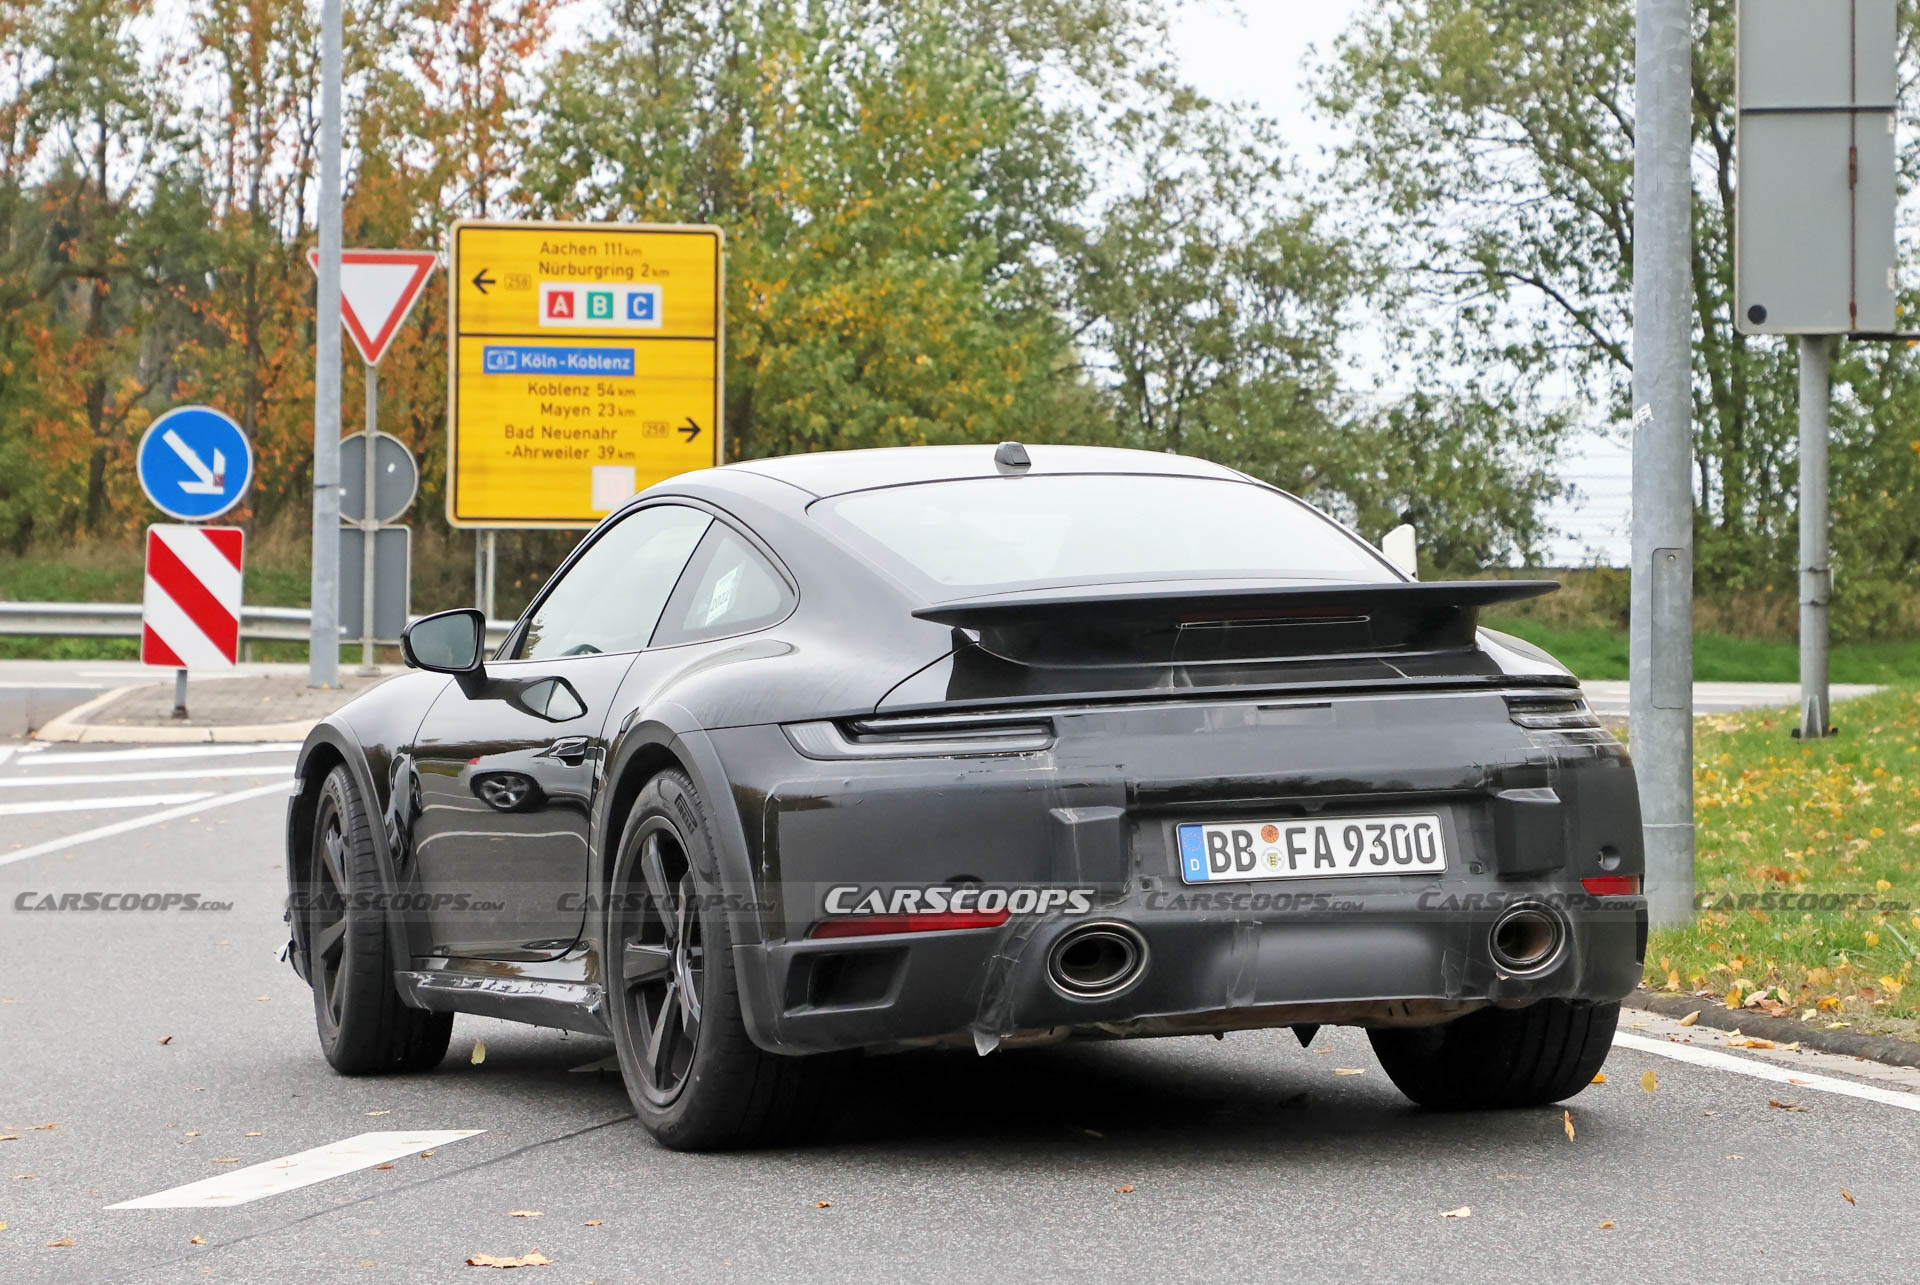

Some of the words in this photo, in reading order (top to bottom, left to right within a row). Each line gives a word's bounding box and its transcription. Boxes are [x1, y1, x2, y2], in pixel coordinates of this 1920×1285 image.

[540, 241, 597, 256] Aachen
[604, 242, 622, 257] 111
[539, 261, 634, 280] Nürburgring
[641, 264, 650, 278] 2
[652, 268, 670, 277] km
[551, 294, 569, 316] A
[592, 295, 608, 316] B
[632, 295, 648, 317] C
[528, 382, 590, 397] Koblenz
[597, 384, 615, 397] 54
[618, 388, 636, 397] km
[540, 402, 591, 419] Mayen
[597, 403, 615, 417] 23
[618, 408, 636, 417] km
[504, 425, 535, 440] Bad
[541, 426, 617, 440] Neuenahr
[505, 445, 590, 460] -Ahrweiler
[597, 446, 615, 460] 39
[618, 450, 636, 460] km
[674, 791, 698, 835] PIRELLI
[1206, 829, 1257, 873] BB
[1285, 826, 1336, 870] FA
[1343, 823, 1437, 868] 9300
[1189, 858, 1200, 871] D
